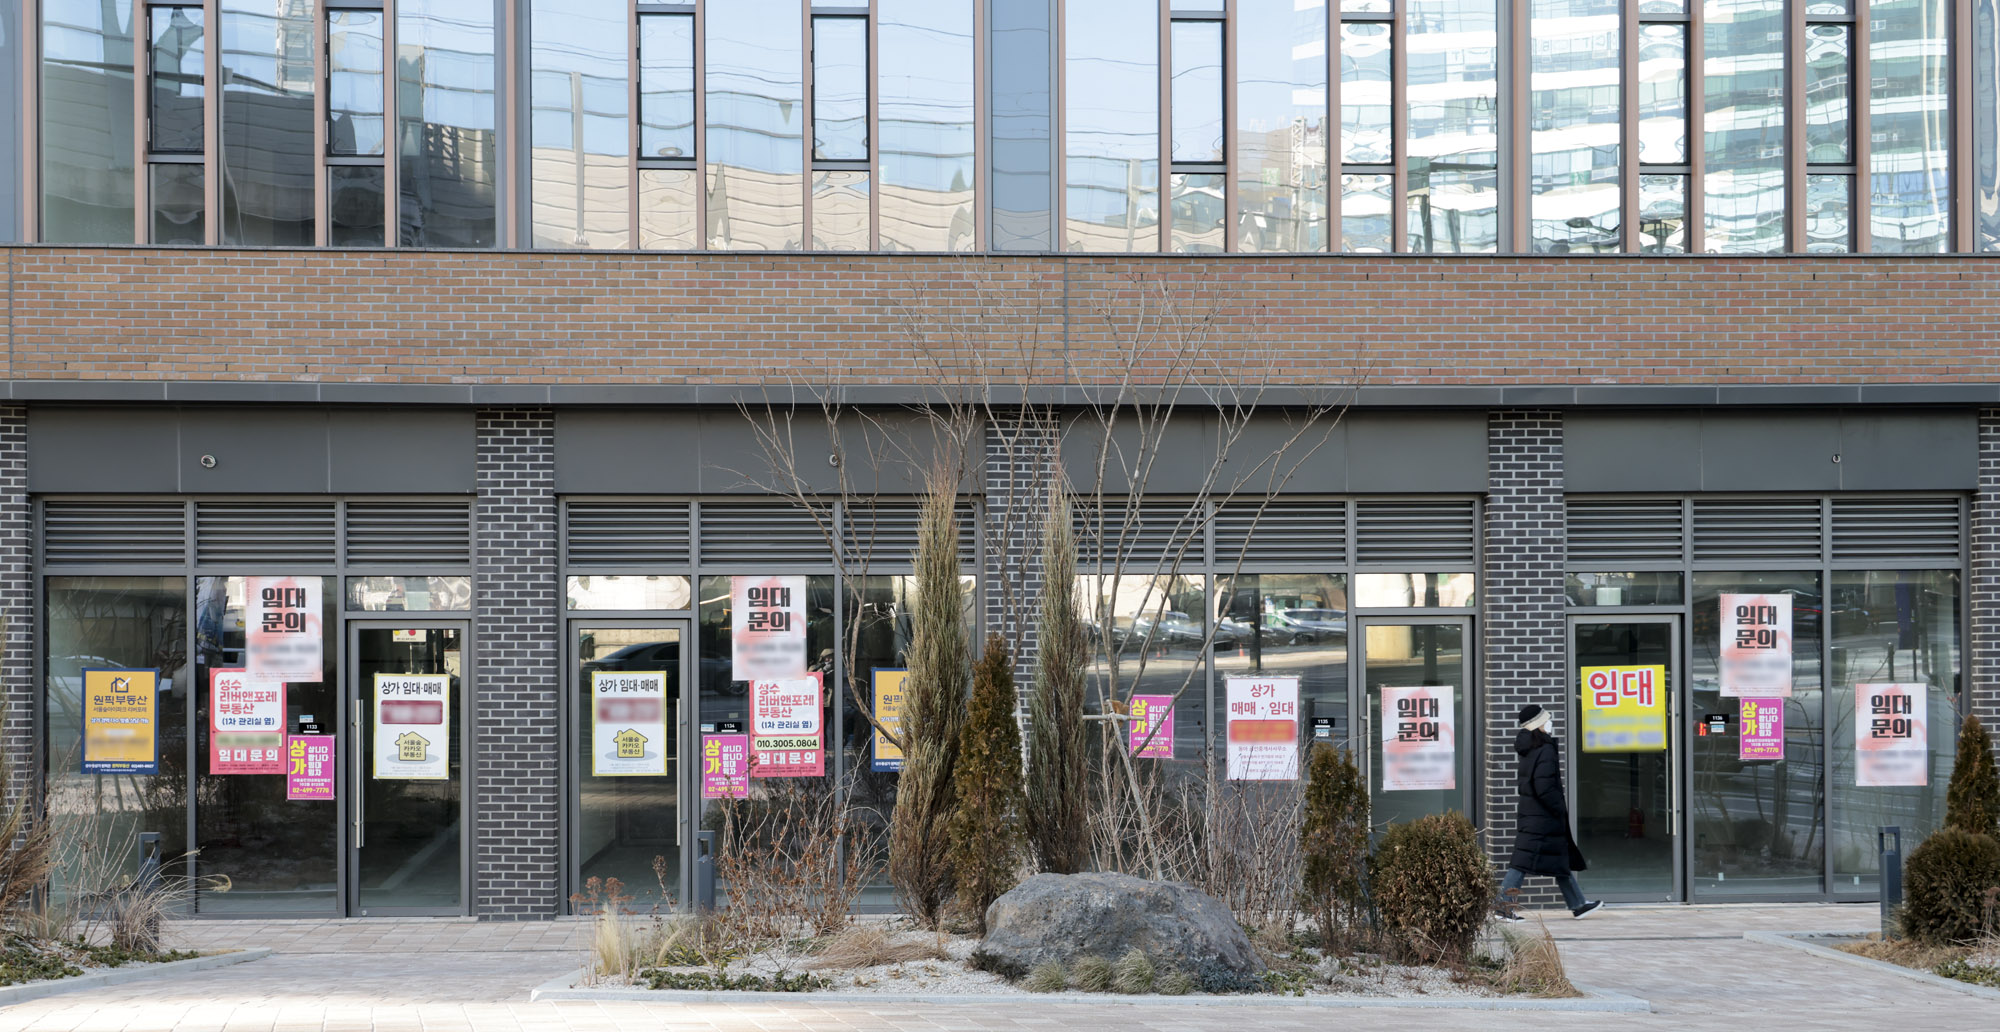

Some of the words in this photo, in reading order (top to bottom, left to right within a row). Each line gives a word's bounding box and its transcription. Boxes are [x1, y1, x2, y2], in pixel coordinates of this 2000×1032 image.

[262, 588, 306, 608] 임대
[748, 587, 790, 607] 임대
[262, 612, 306, 632] 문의
[748, 612, 790, 632] 문의
[1736, 605, 1777, 625] 임대
[1736, 629, 1777, 649] 문의
[220, 680, 242, 691] 성수
[381, 681, 400, 695] 상가
[599, 679, 617, 692] 상가
[758, 684, 780, 695] 성수
[1250, 684, 1276, 698] 상가
[1589, 670, 1653, 706] 임대
[220, 691, 277, 703] 리버앤포레
[759, 695, 814, 706] 리버앤포레
[220, 703, 254, 715] 부동산
[1231, 701, 1256, 715] 매매
[1269, 701, 1294, 715] 임대
[1397, 698, 1439, 718] 임대
[1871, 695, 1912, 714] 임대
[758, 707, 792, 718] 부동산
[1742, 702, 1758, 736] 상가
[222, 717, 236, 726] (1차
[238, 717, 262, 725] 관리실
[264, 717, 275, 726] 옆)
[761, 721, 775, 729] (1차
[777, 721, 800, 729] 관리실
[802, 721, 812, 729] 옆)
[1871, 718, 1912, 738] 문의
[1397, 722, 1439, 742] 문의
[757, 739, 817, 748] 010.3005.0804
[218, 749, 278, 762] 임대문의
[290, 740, 307, 775] 상가
[705, 740, 722, 774] 상가
[758, 752, 816, 765] 임대문의
